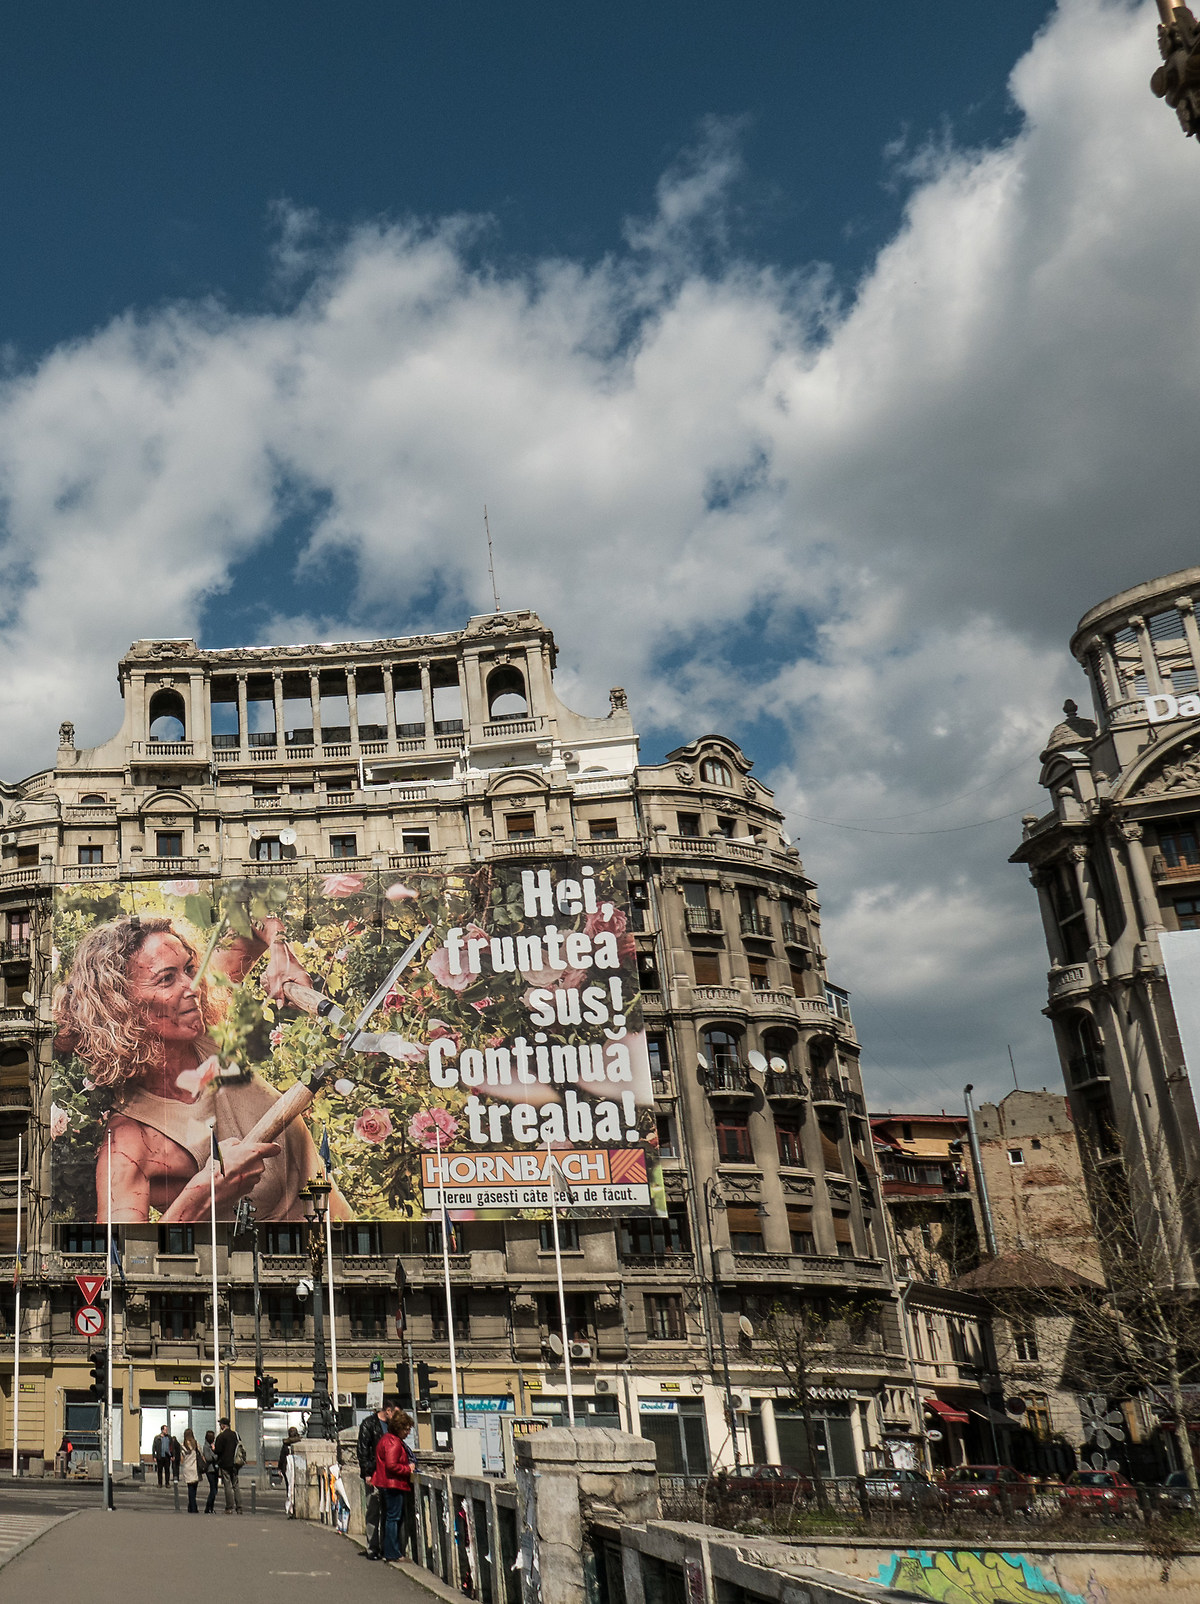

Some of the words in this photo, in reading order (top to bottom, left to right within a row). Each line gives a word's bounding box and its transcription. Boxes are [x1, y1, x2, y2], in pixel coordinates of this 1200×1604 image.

[521, 866, 614, 922] Hei,
[444, 924, 620, 974] fruntea
[528, 976, 626, 1027] sus!
[428, 1027, 633, 1088] Continuă
[464, 1090, 640, 1144] treaba!
[426, 1153, 606, 1183] HORNBACH
[523, 1189, 548, 1203] câte
[584, 1188, 598, 1201] de
[602, 1187, 637, 1201] făcut.
